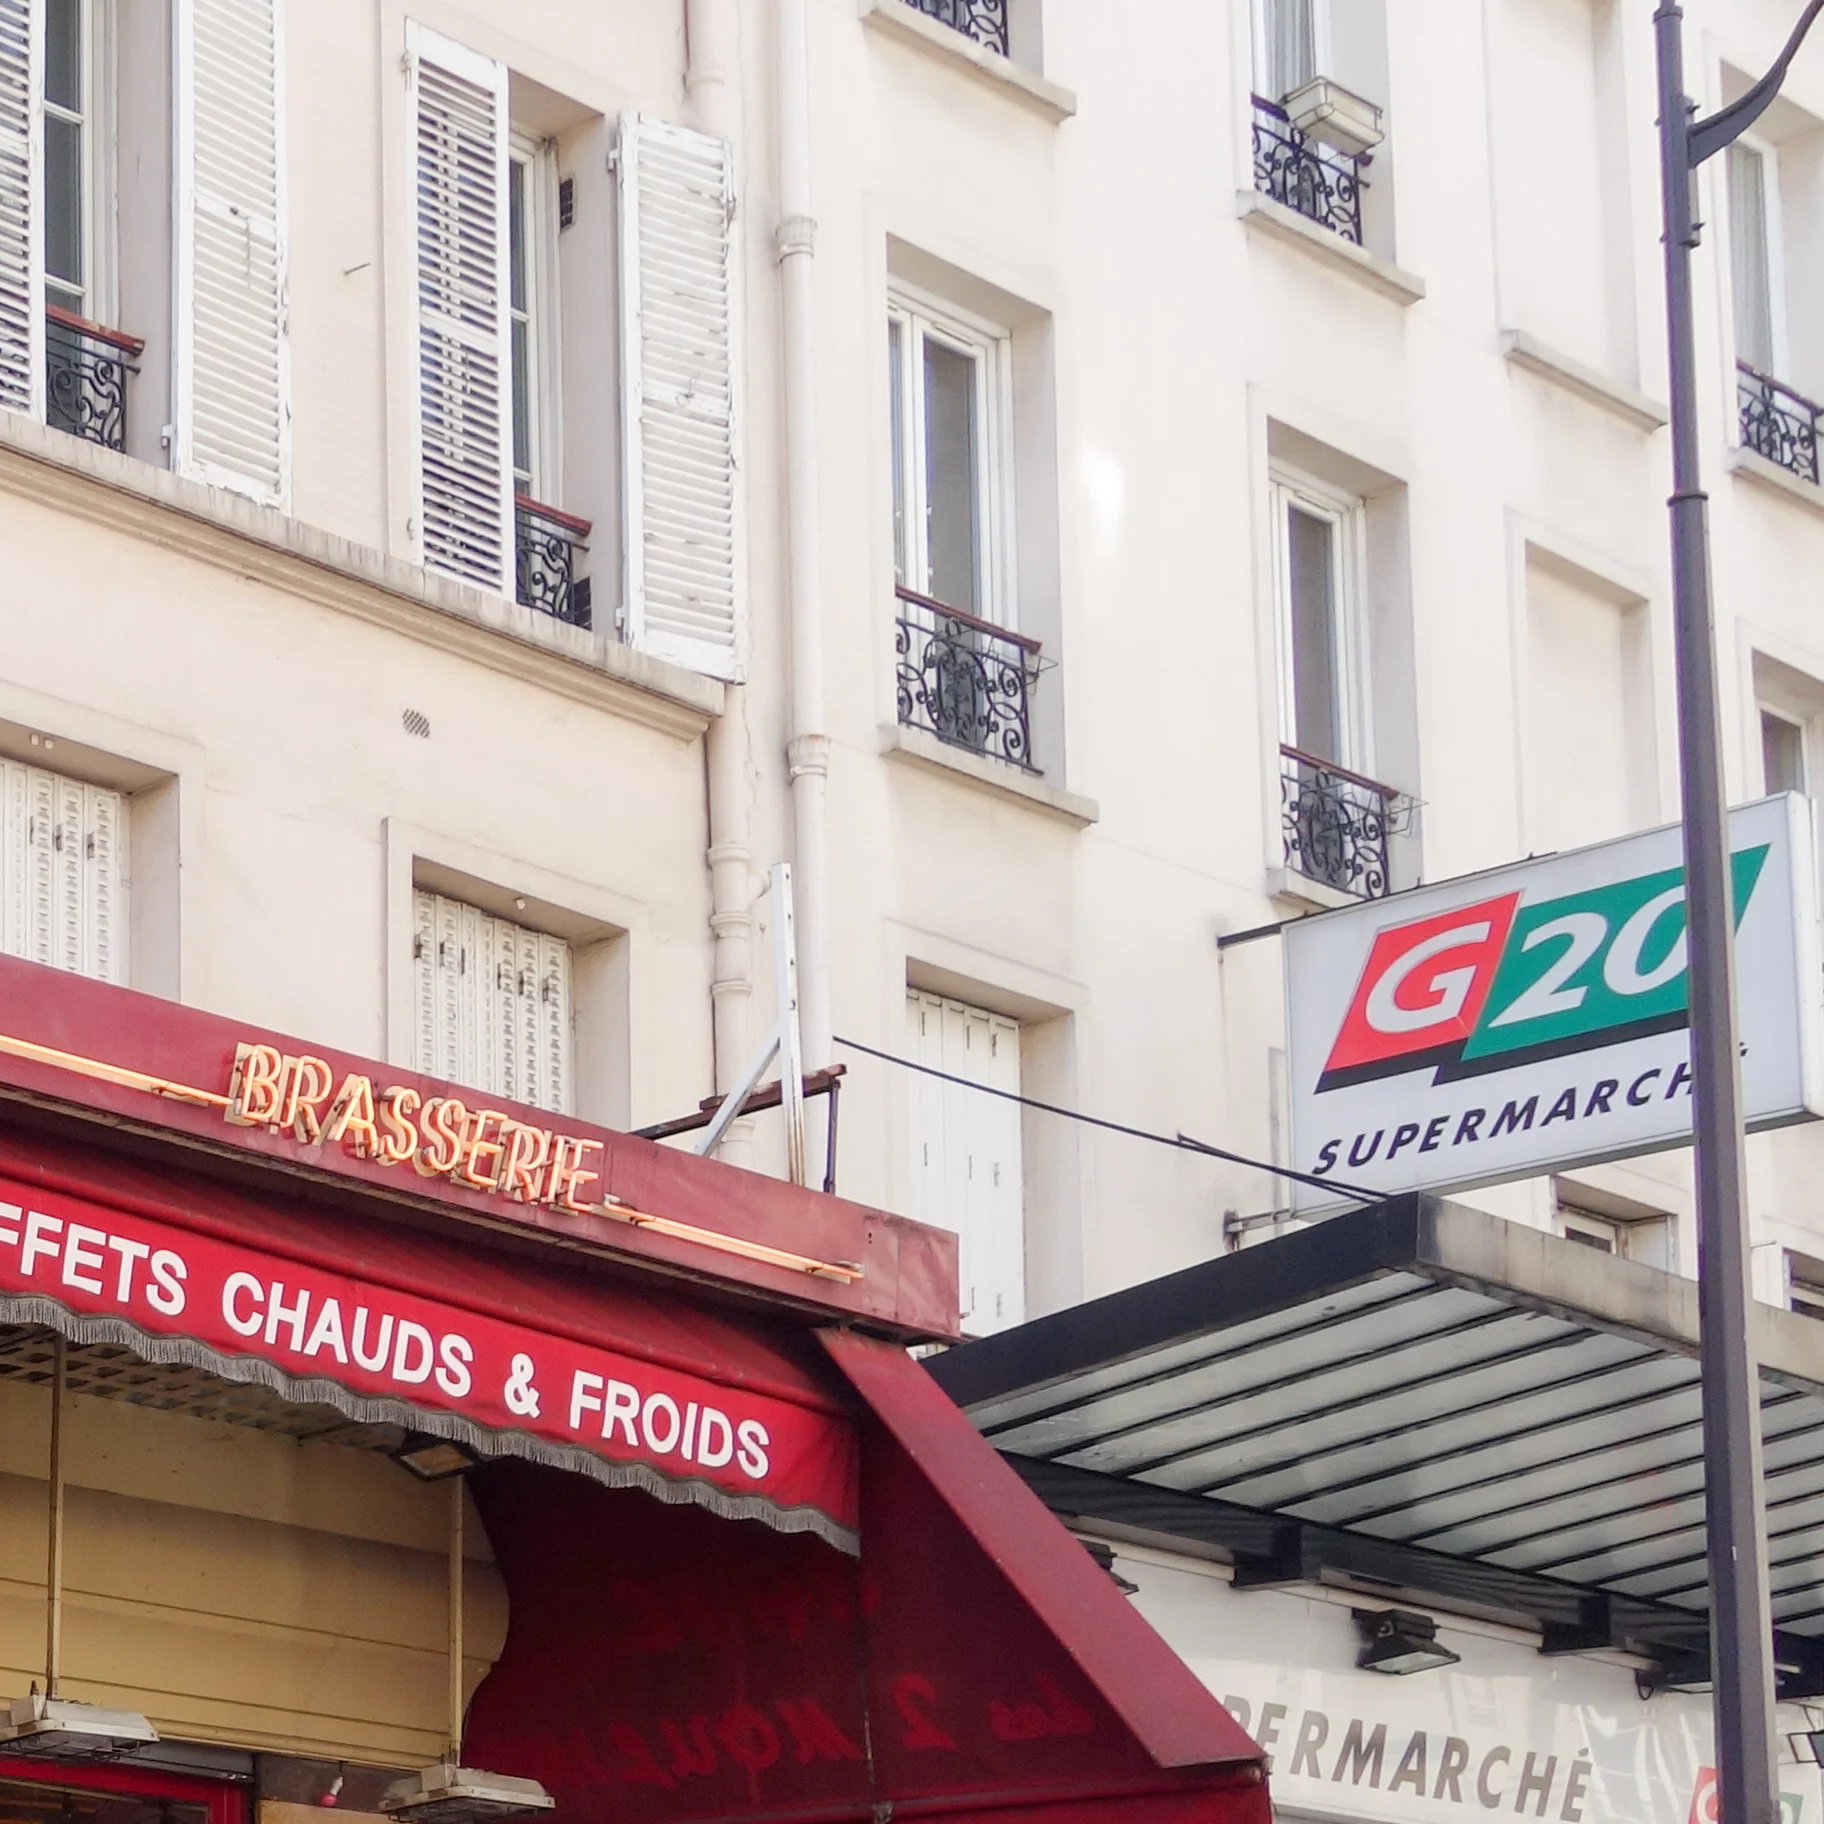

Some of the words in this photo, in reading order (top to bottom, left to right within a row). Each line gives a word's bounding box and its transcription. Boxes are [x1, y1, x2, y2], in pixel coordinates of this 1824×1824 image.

[1365, 882, 1692, 1033] G20
[229, 1040, 605, 1216] BRASSERIE
[1312, 1044, 1748, 1175] SUPERMARCH
[222, 1270, 474, 1400] CHAUDS
[503, 1352, 541, 1418] &
[569, 1371, 772, 1480] FROIDS
[1222, 1694, 1593, 1823] PERMARCHÉ
